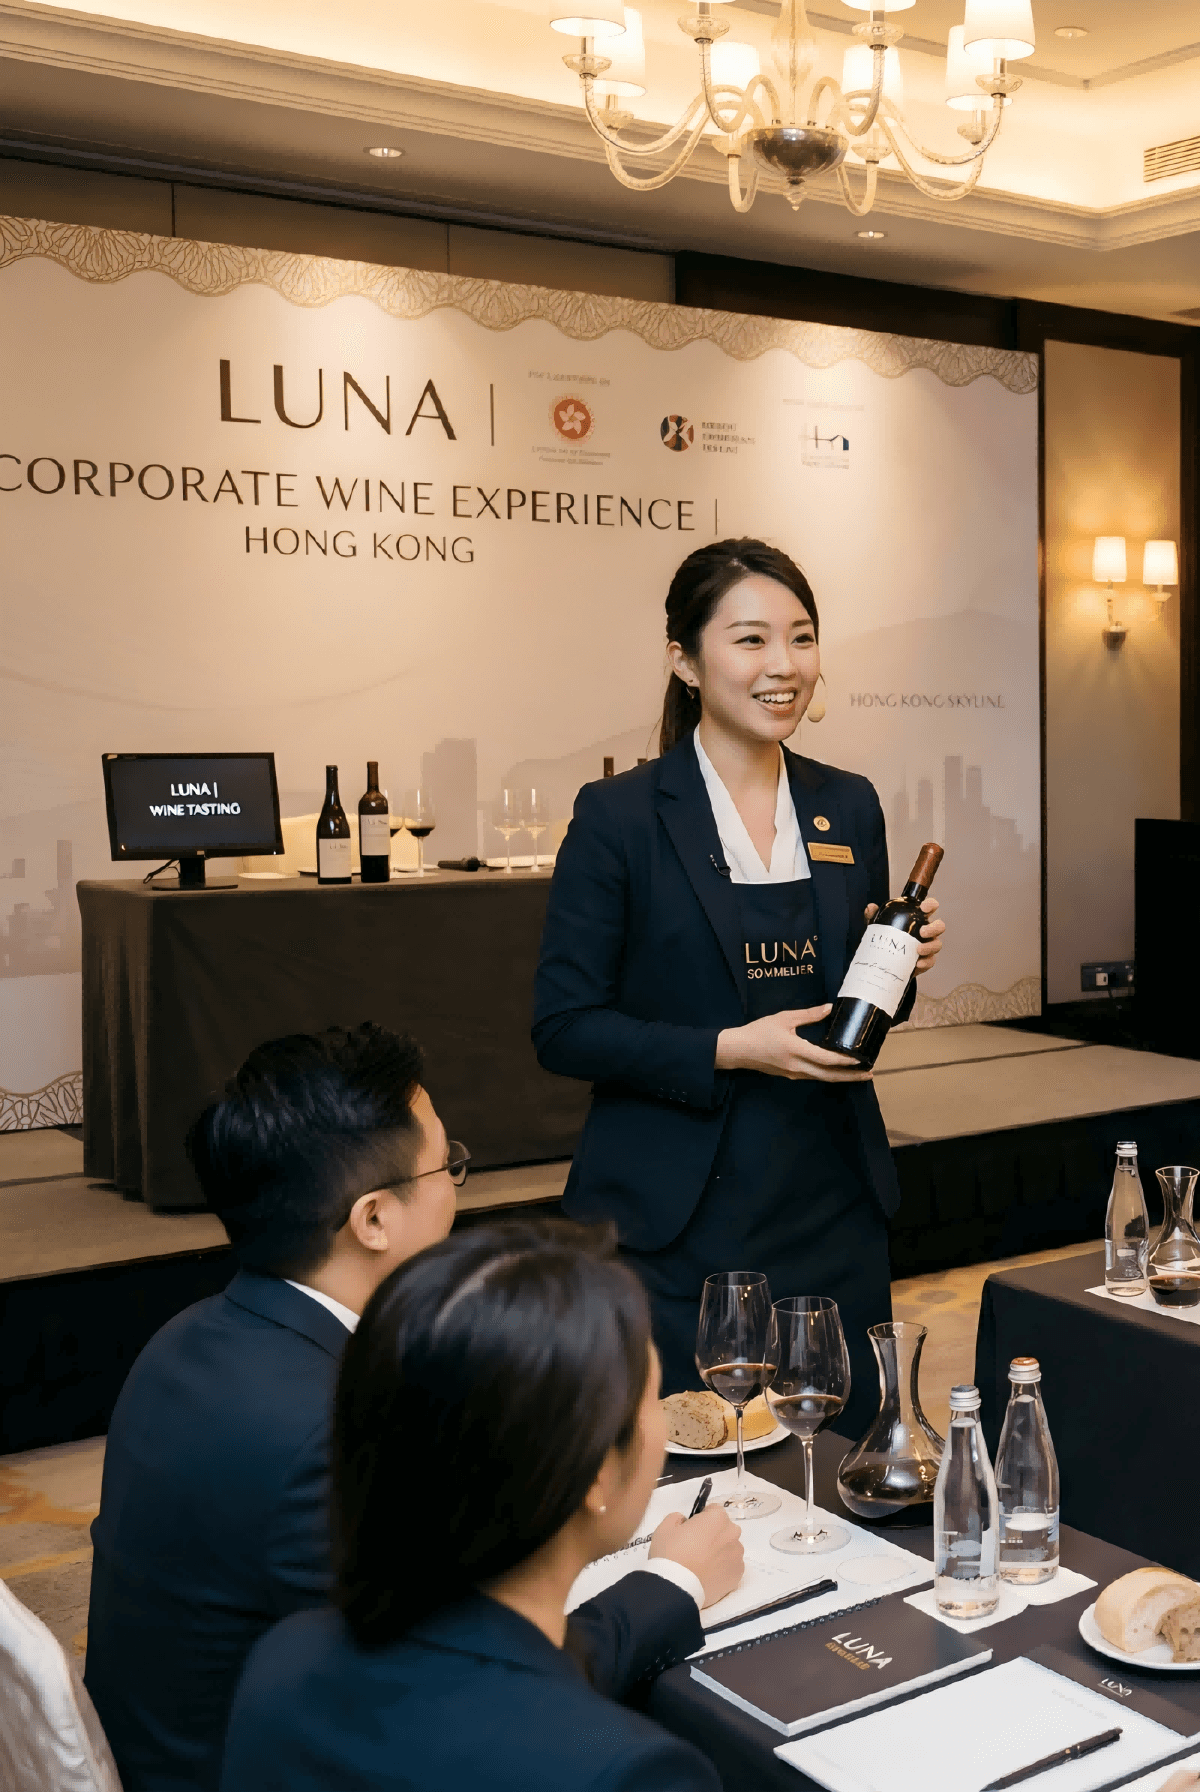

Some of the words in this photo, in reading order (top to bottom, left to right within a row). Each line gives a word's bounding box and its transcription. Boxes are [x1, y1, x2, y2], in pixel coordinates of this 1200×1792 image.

[219, 359, 457, 441] LUNA
[0, 454, 299, 507] CORPORATE
[315, 475, 435, 516] WINE
[452, 484, 696, 532] EXPERIENCE
[245, 526, 357, 558] HONG
[373, 533, 475, 564] KONG
[850, 692, 897, 708] HONG
[901, 693, 945, 709] KONG
[947, 693, 1006, 709] SKYLINE
[170, 782, 212, 797] LUNA
[149, 804, 185, 817] WINE
[745, 938, 817, 964] LUNA
[747, 964, 814, 979] SOMMELIER
[831, 1632, 893, 1669] LUNA
